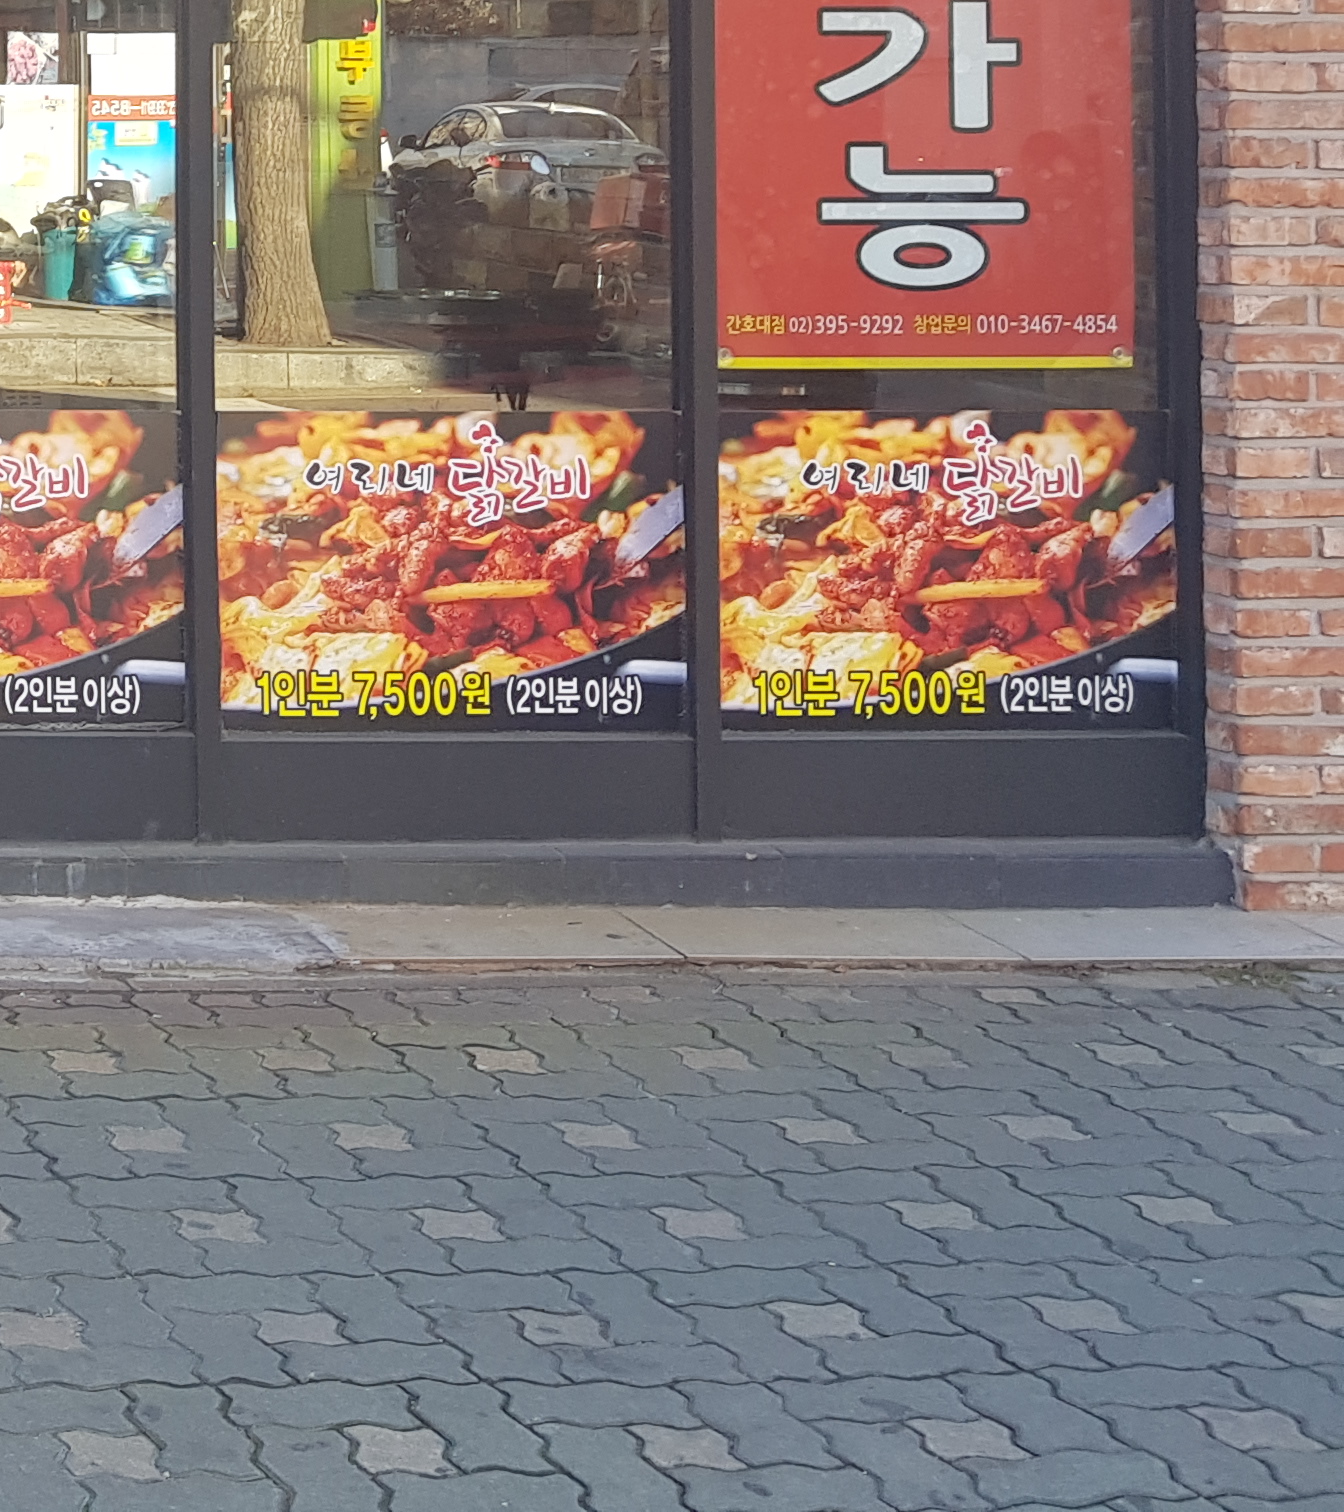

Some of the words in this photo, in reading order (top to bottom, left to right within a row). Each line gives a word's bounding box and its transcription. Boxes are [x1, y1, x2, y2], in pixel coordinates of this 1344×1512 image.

[726, 315, 786, 335] 간호대점
[913, 315, 972, 335] 창업문의
[976, 313, 1118, 335] 010-3467-4854
[303, 458, 435, 494] 여리네
[447, 453, 591, 527] 닭갈비
[800, 458, 931, 494] 여리네
[943, 453, 1084, 526] 닭갈비
[4, 674, 77, 716] (2인분
[81, 674, 142, 716] 이상)
[256, 669, 344, 719] 1인분
[352, 670, 493, 722] 7,500원
[506, 675, 580, 717] (2인분
[584, 675, 644, 717] 이상)
[752, 669, 839, 719] 1인분
[847, 669, 987, 722] 7,500원
[999, 674, 1074, 716] (2인분
[1077, 674, 1135, 716] 이상)
